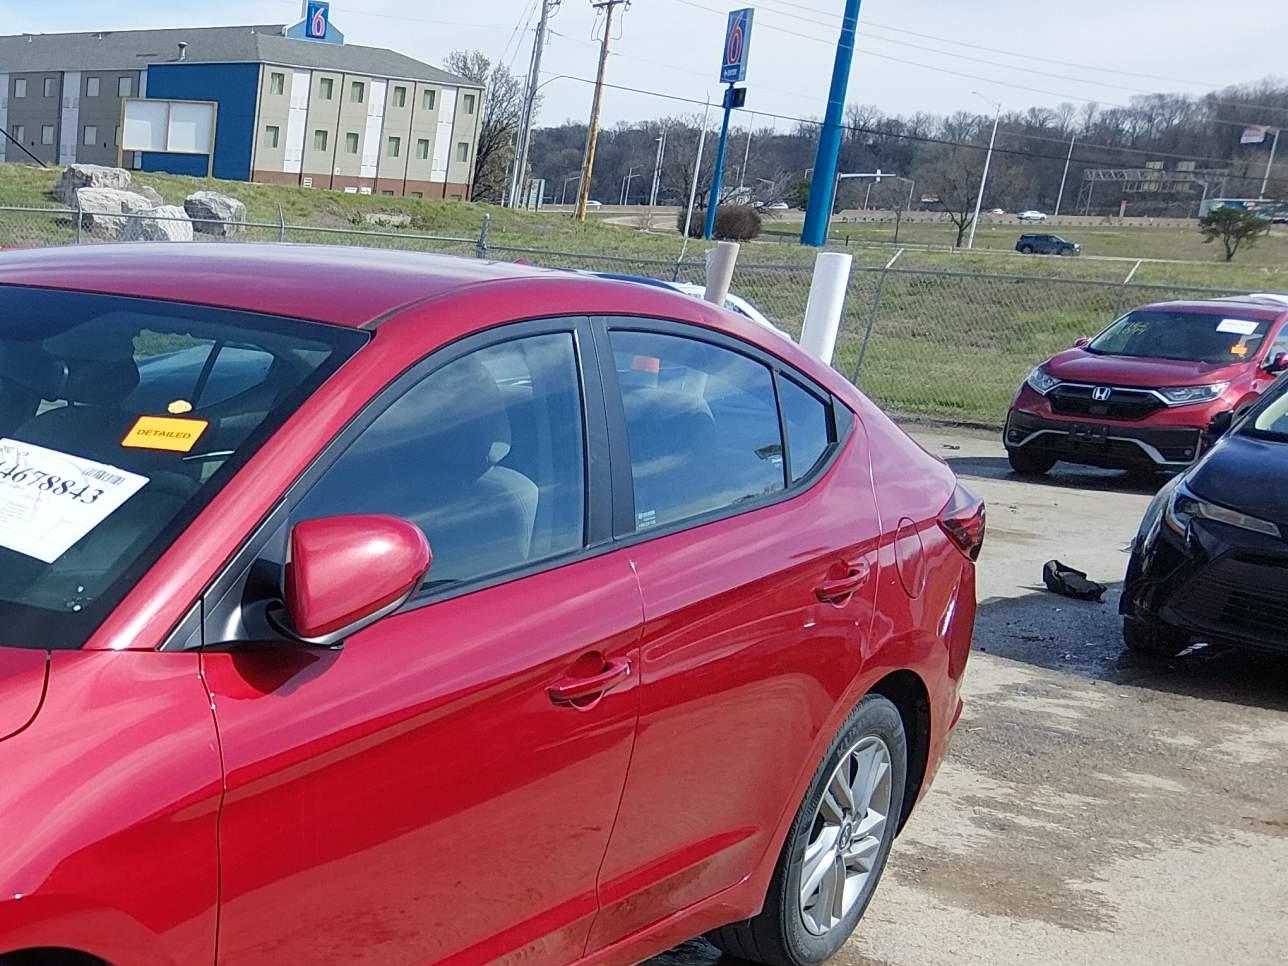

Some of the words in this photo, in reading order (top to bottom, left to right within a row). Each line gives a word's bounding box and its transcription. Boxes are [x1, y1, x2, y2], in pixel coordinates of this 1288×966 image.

[312, 8, 326, 37] 6
[727, 11, 745, 65] 6
[137, 428, 191, 440] DETAILED
